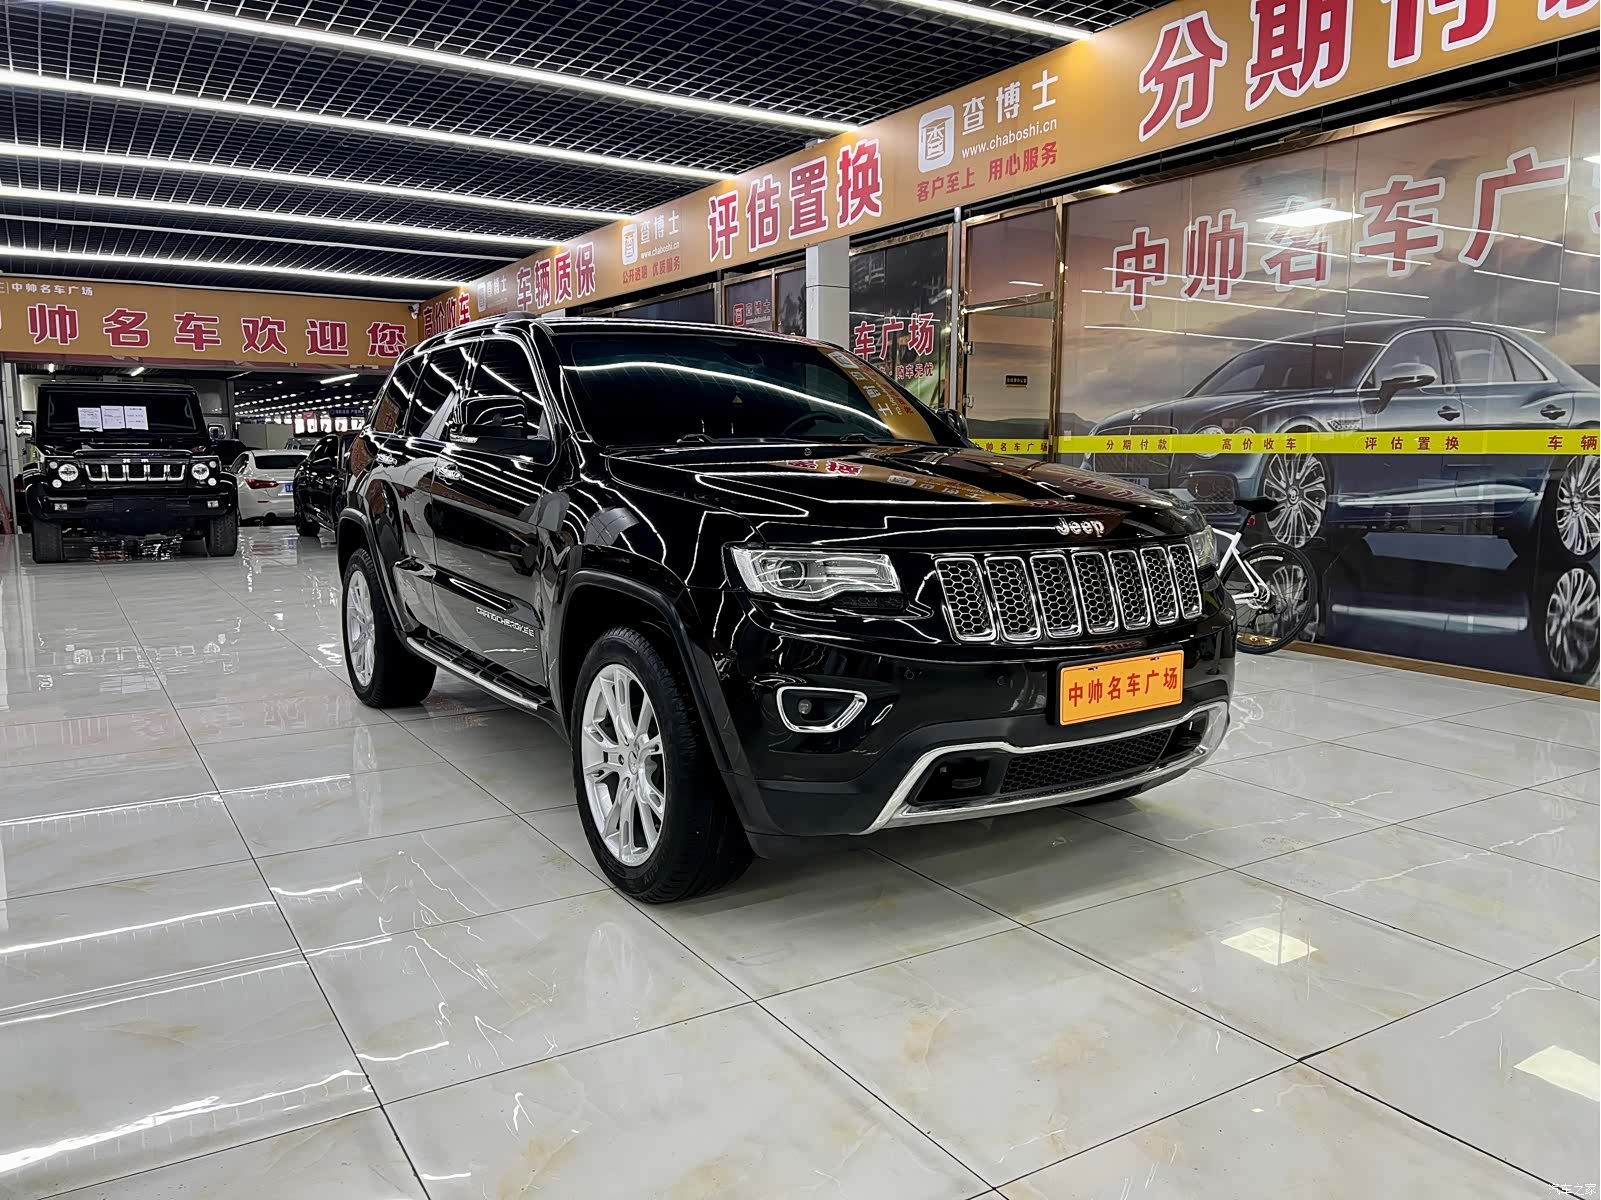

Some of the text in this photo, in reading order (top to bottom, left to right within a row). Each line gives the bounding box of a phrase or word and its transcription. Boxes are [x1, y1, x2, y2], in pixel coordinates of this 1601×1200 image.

[1138, 0, 1601, 142] 分期付
[962, 69, 1059, 136] 查博士
[961, 119, 1057, 159] www.chaboshi.cn
[916, 141, 1058, 203] 客户至上 用心服务
[708, 138, 882, 262] 评估置换
[640, 210, 680, 244] 查博士
[1112, 146, 1601, 312] 中帅名车广
[11, 283, 94, 297] 中帅名车广场
[517, 242, 596, 312] 车辆质保
[652, 256, 680, 277] 优质服务
[0, 303, 407, 358] 帅名车欢迎您
[423, 292, 471, 343] 高价收车
[854, 312, 935, 362] 车广场
[1106, 435, 1598, 451] 分期付款 高价收车 评估置换 车辆
[1055, 517, 1105, 537] Jeep
[1068, 667, 1178, 707] 中帅名车广场
